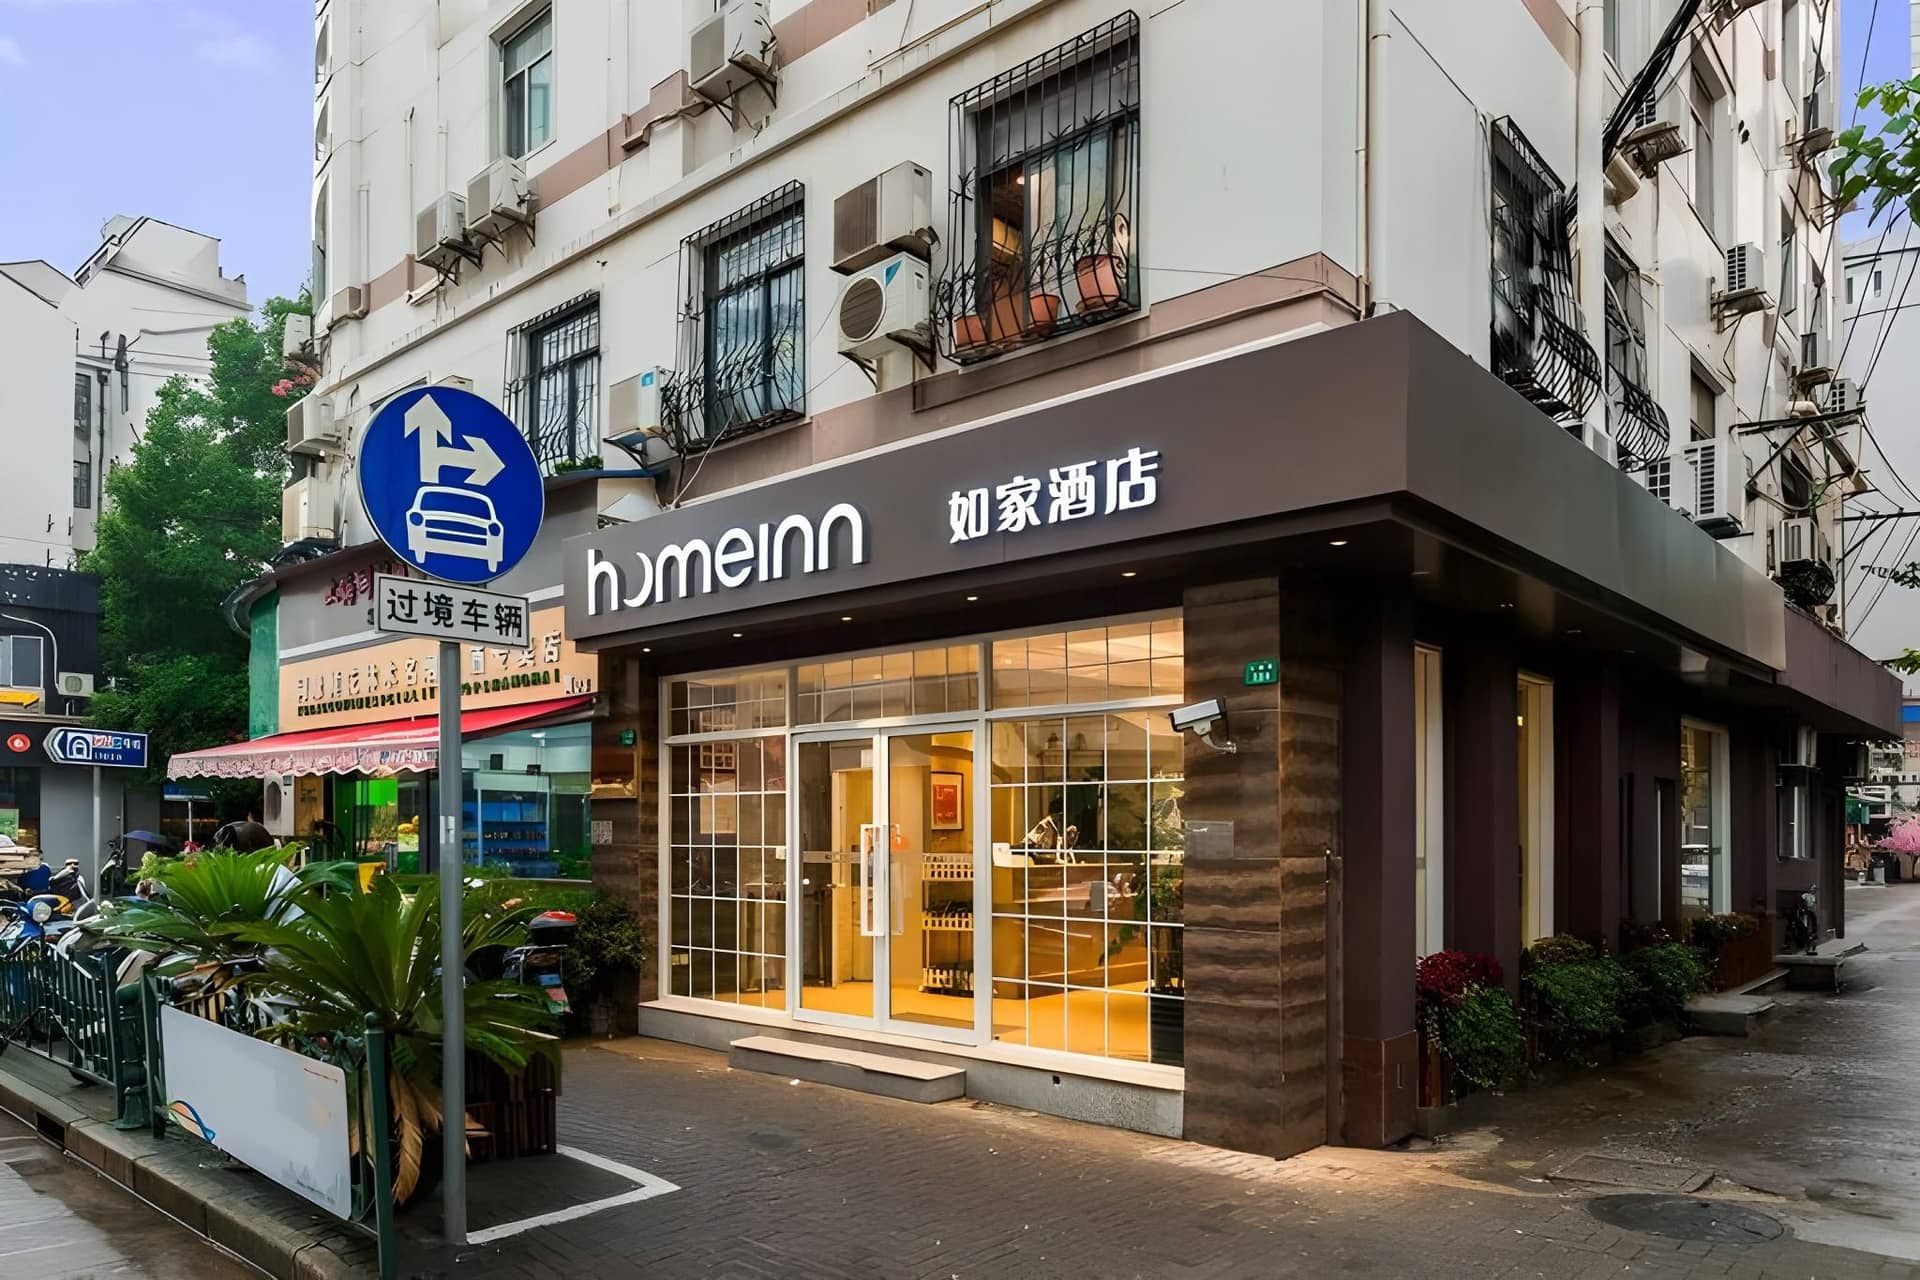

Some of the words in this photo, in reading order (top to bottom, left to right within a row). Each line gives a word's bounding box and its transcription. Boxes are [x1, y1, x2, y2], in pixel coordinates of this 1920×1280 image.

[948, 447, 1160, 545] 如家酒店
[587, 501, 864, 616] homeinn
[386, 587, 523, 639] 过境车辆
